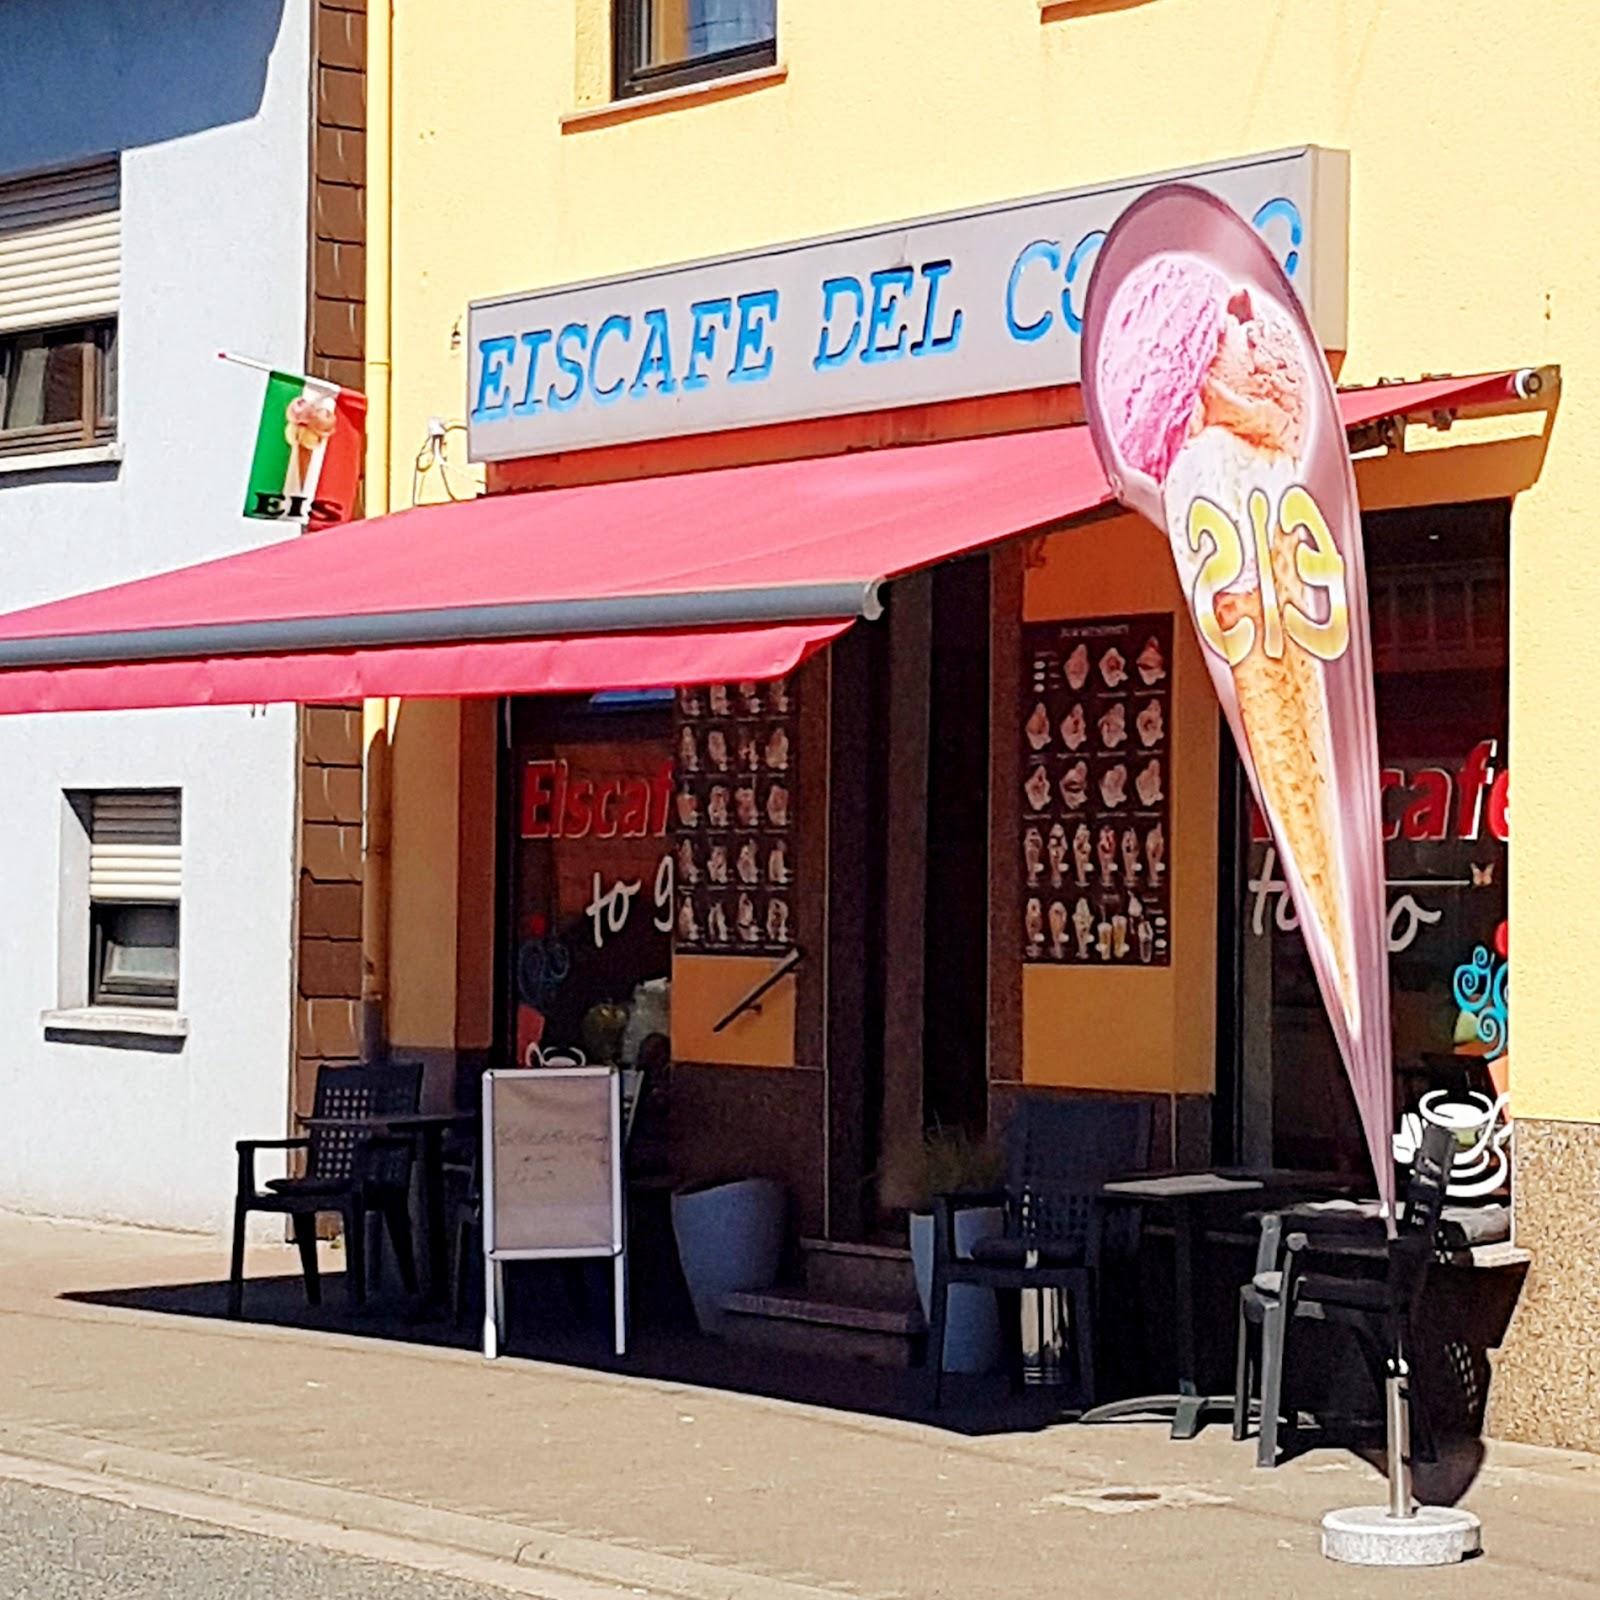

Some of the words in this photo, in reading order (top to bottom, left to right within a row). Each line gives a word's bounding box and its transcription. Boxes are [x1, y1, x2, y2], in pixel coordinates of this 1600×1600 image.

[471, 289, 778, 422] EISCAFE
[813, 259, 962, 371] DEL
[1006, 197, 1302, 342] COO
[252, 492, 343, 521] EIS
[585, 871, 641, 948] to
[1248, 847, 1300, 936] to
